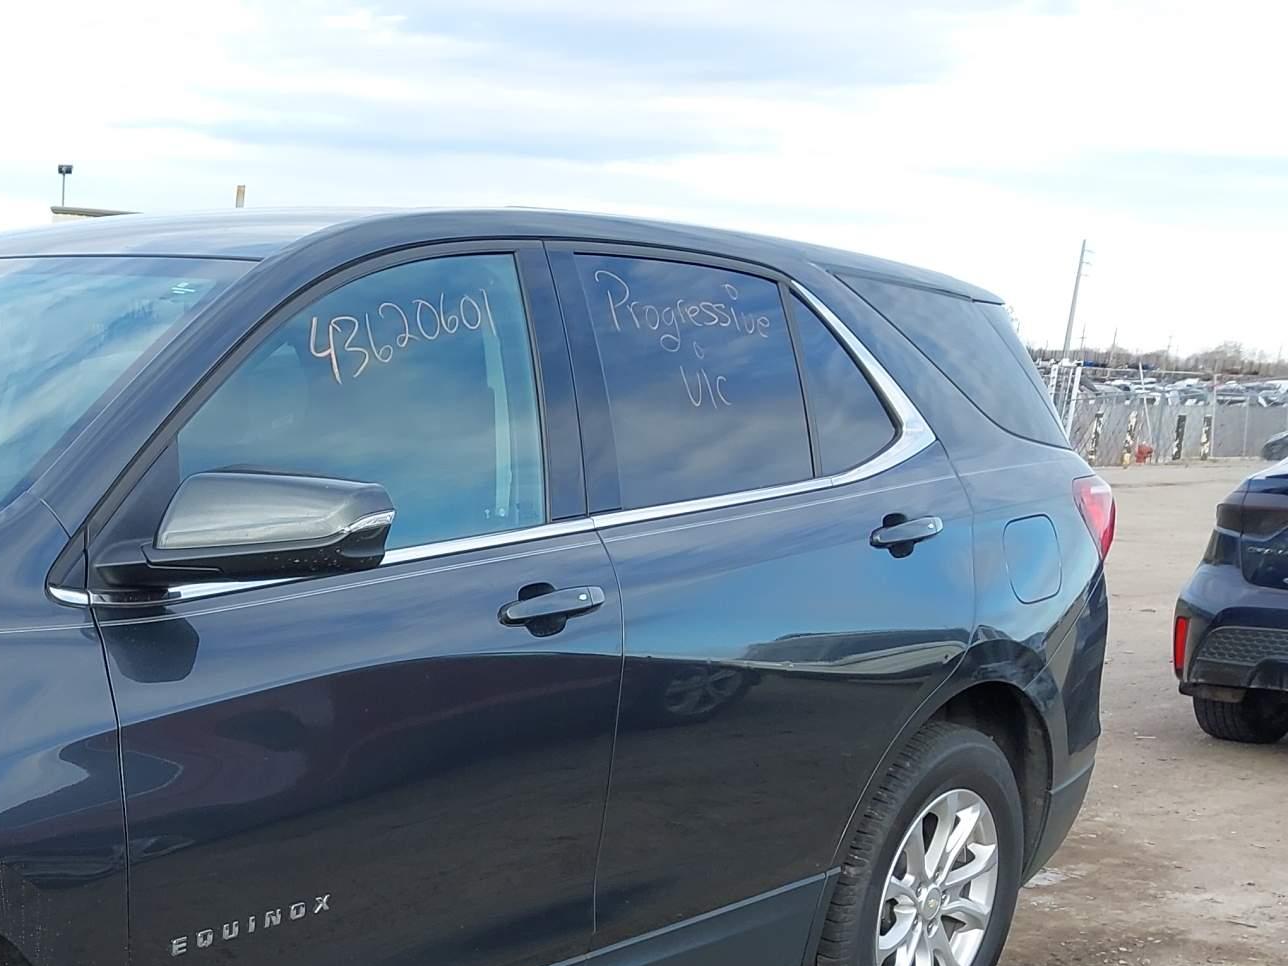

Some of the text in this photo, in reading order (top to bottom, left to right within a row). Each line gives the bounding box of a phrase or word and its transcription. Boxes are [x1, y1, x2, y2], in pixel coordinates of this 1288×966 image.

[310, 289, 497, 385] 43620601
[595, 270, 770, 353] Progressive
[170, 894, 331, 957] EQUINOX
